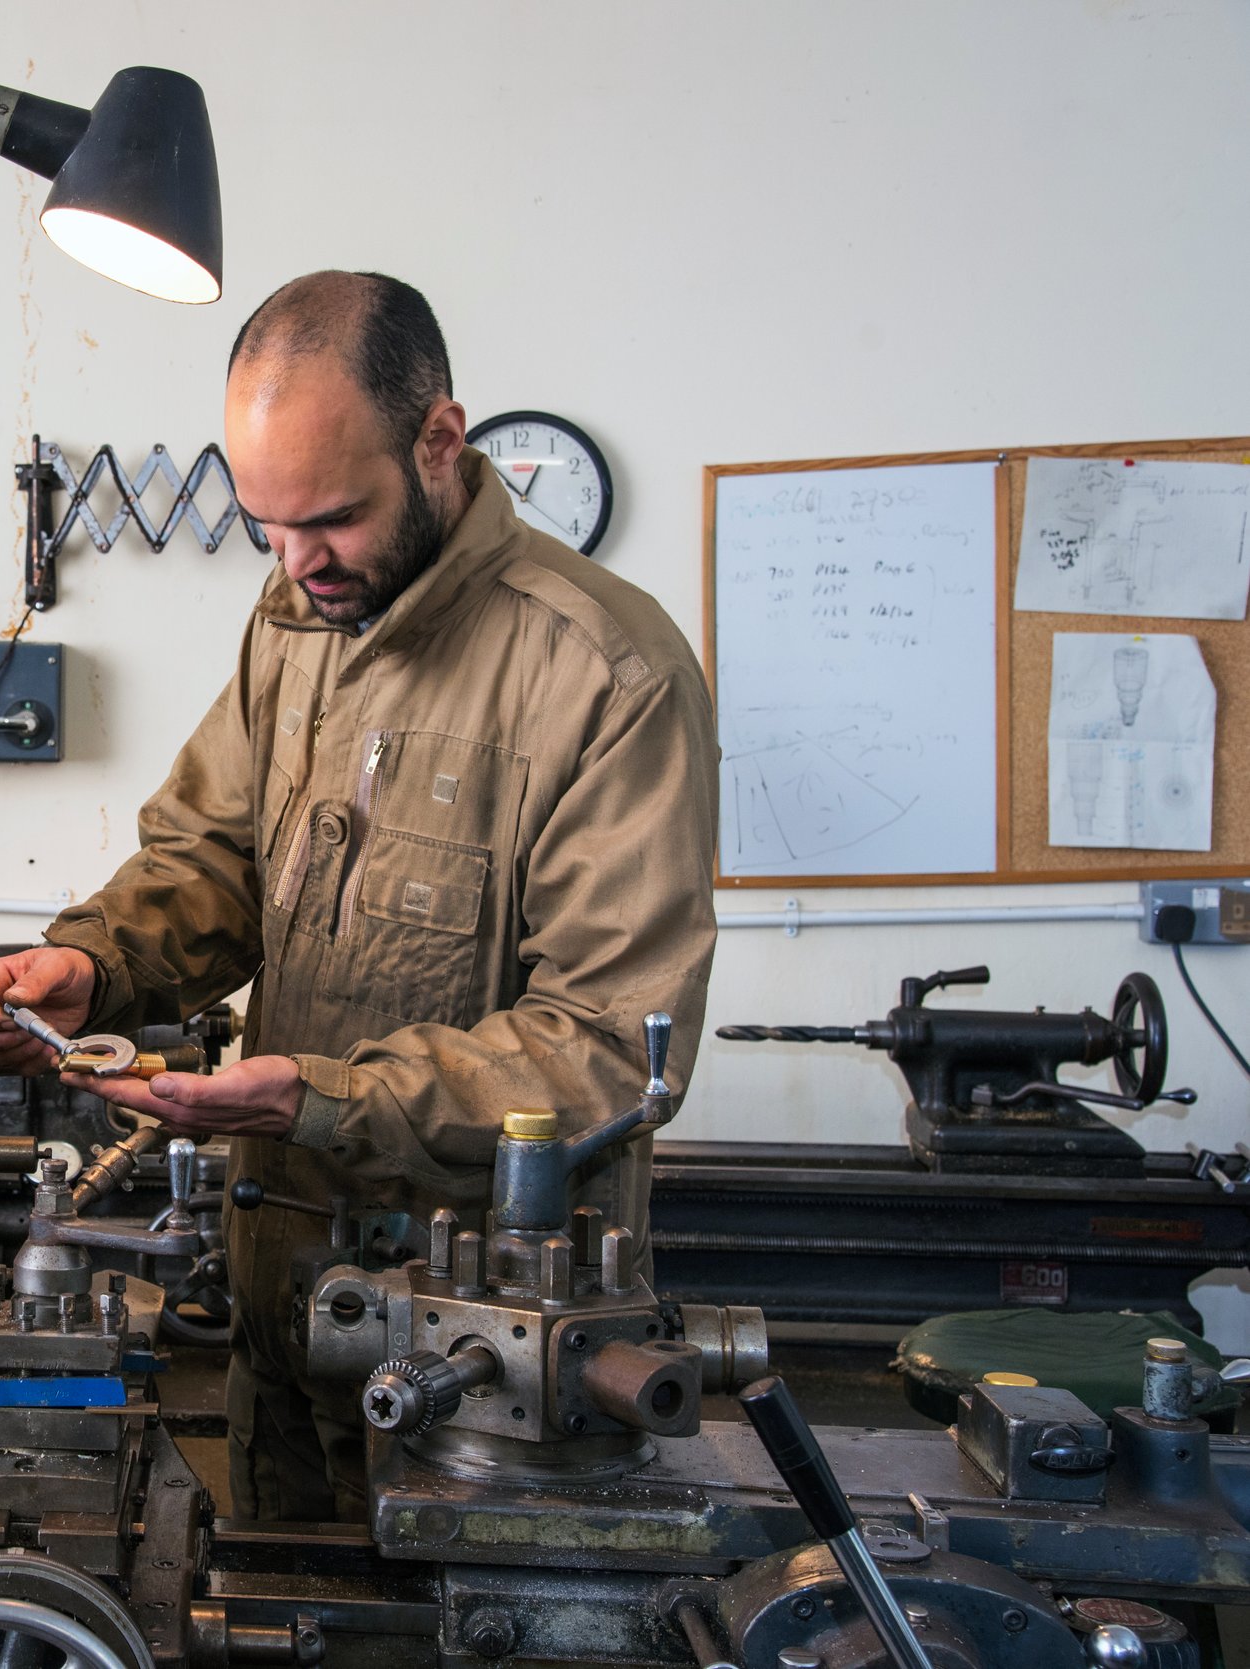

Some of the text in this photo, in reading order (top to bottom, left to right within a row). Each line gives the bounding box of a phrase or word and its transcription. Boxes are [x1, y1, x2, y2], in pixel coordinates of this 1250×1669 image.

[513, 430, 530, 448] 12
[549, 437, 556, 455] 1
[489, 440, 502, 457] 11
[569, 458, 580, 475] 2
[581, 487, 591, 504] 3
[569, 518, 580, 536] 4
